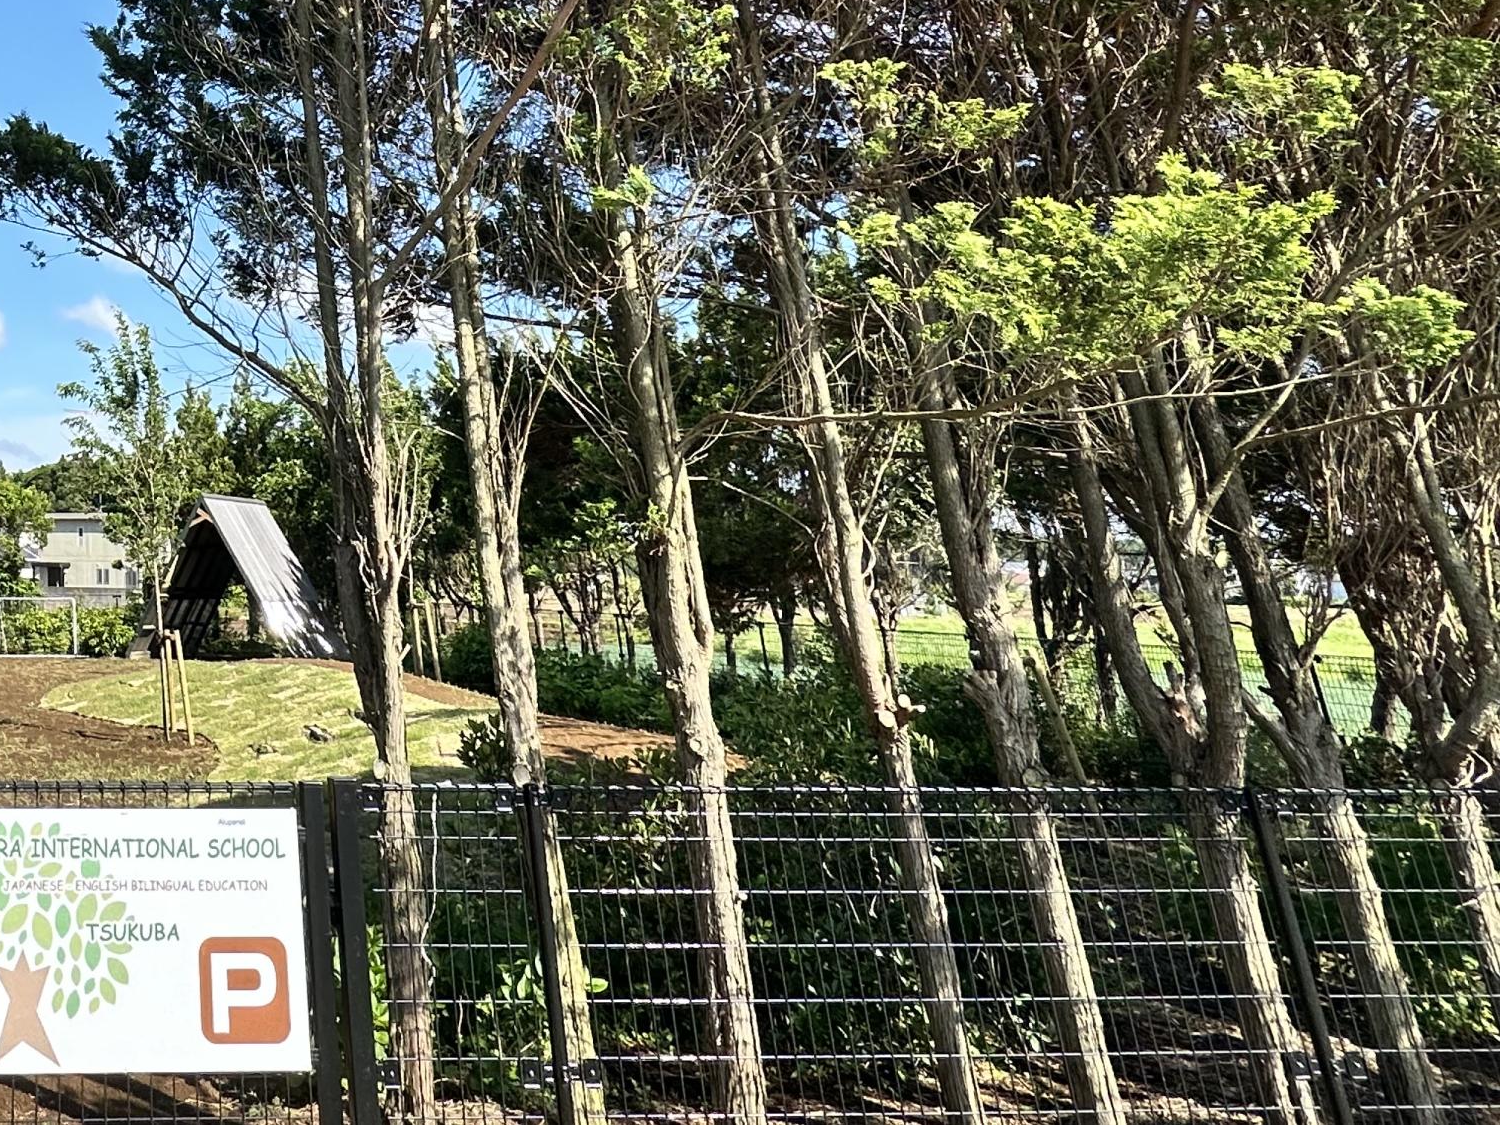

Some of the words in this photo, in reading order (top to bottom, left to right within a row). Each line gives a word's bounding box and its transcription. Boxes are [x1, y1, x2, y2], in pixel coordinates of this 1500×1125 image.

[30, 838, 199, 858] INTERNATIONAL
[207, 838, 286, 858] SCHOOL
[2, 879, 63, 892] JAPANESE
[75, 879, 128, 892] ENGLISH
[131, 879, 195, 892] BILINGUAL
[198, 879, 268, 892] EDUCATION
[85, 923, 180, 941] TSUKUBA
[210, 952, 277, 1034] P
